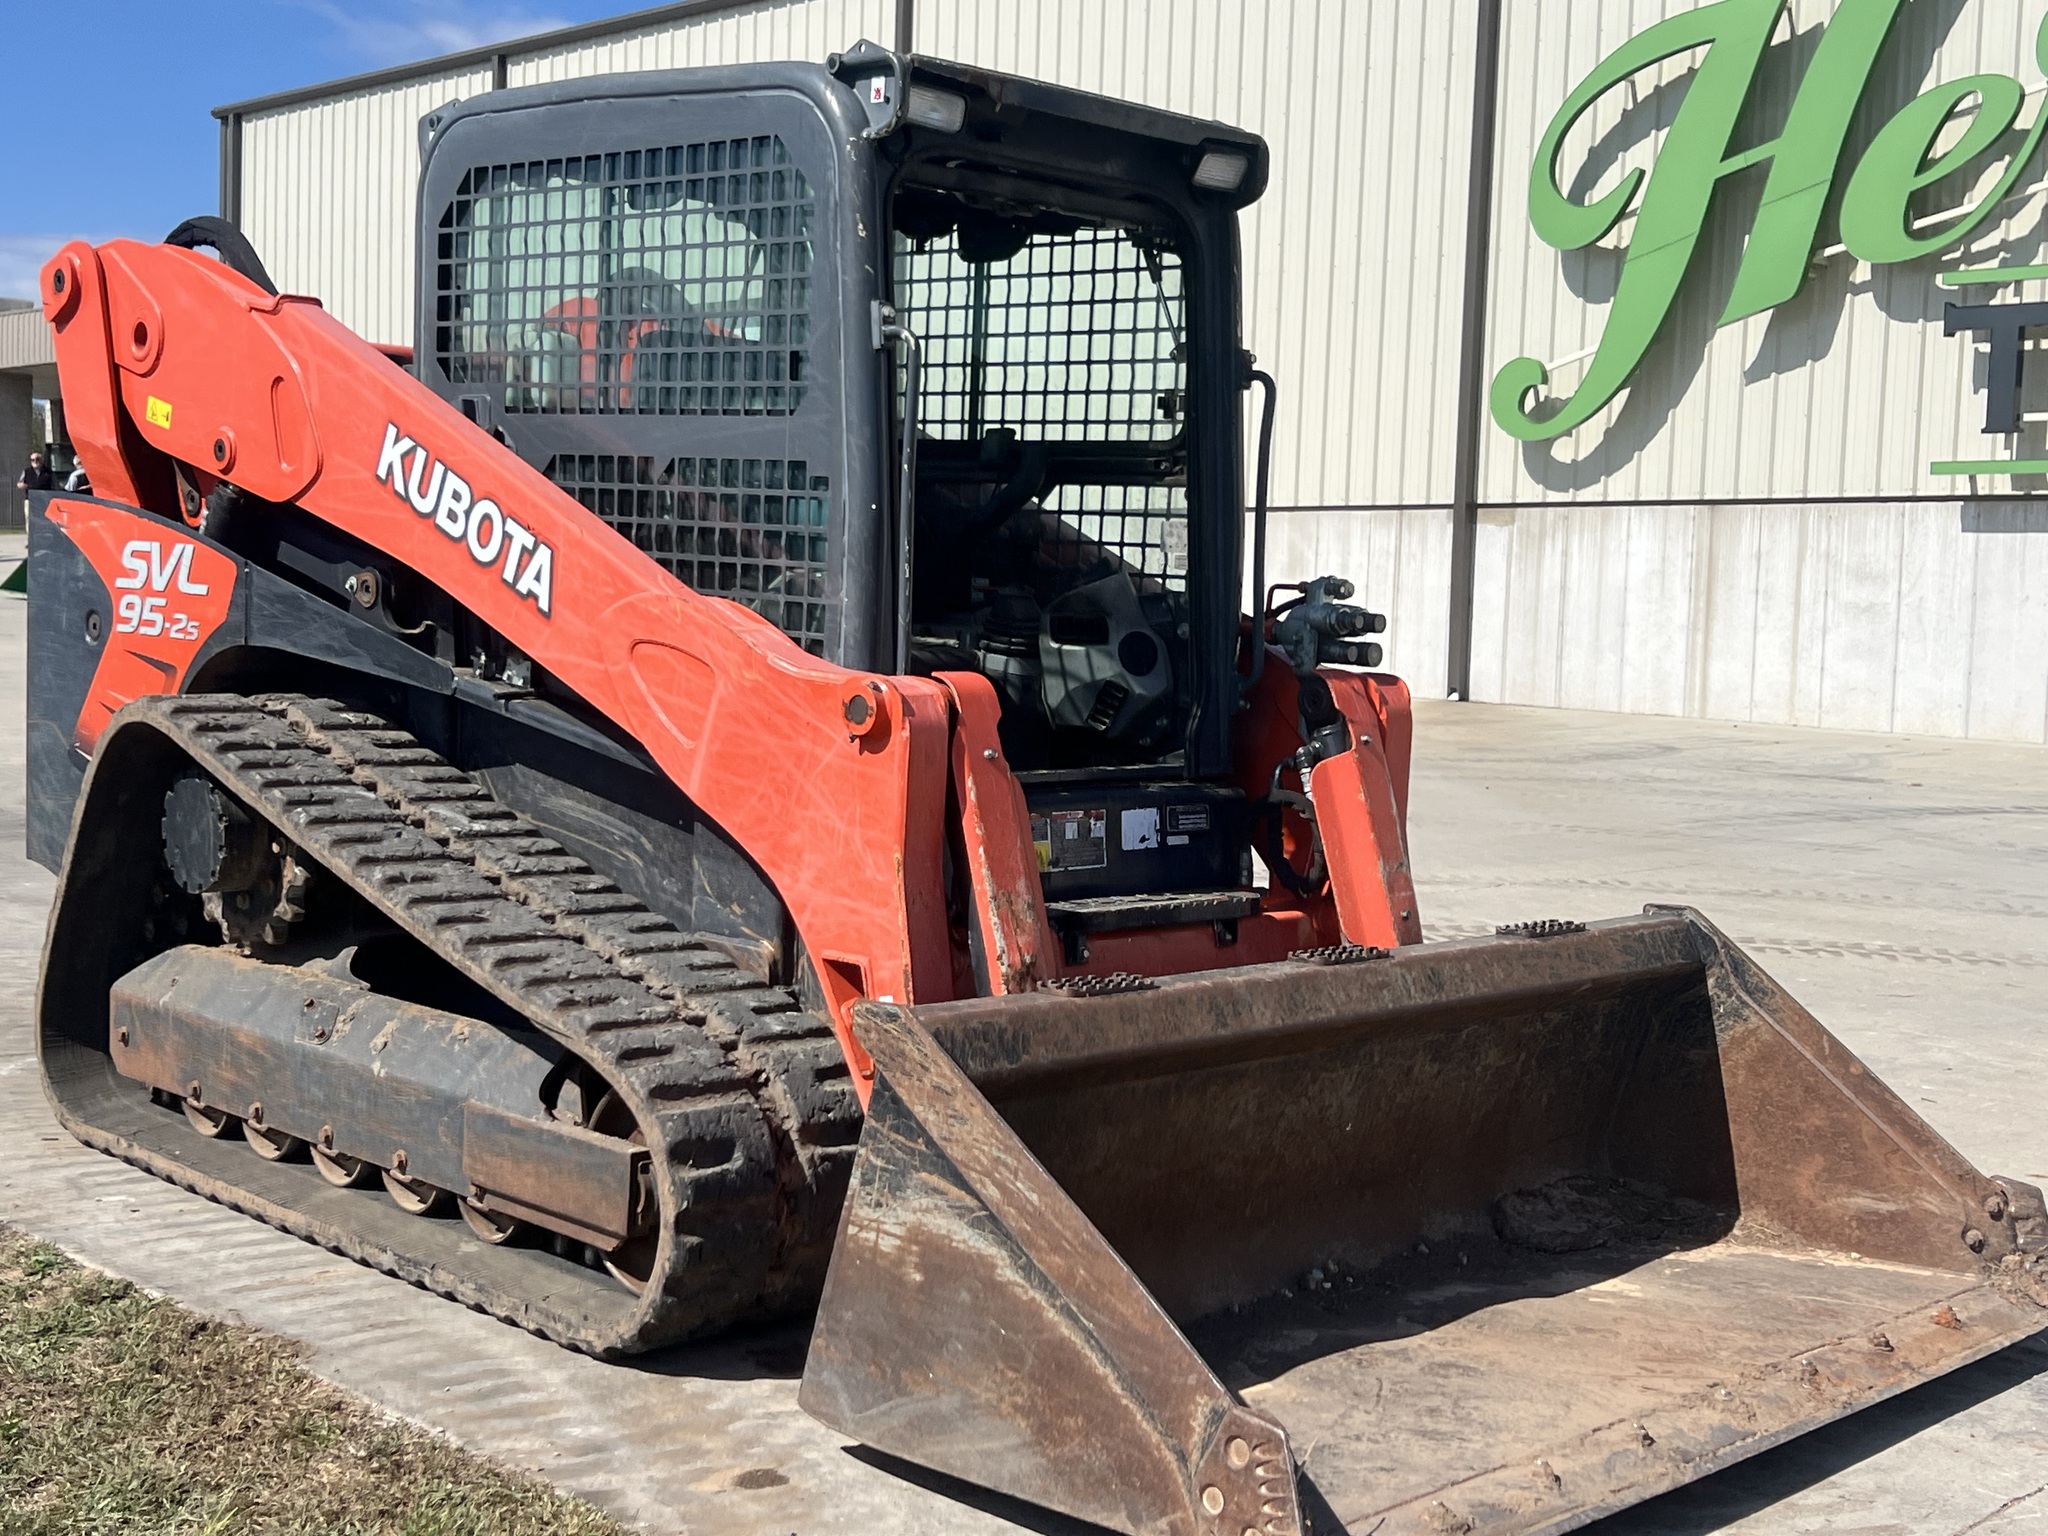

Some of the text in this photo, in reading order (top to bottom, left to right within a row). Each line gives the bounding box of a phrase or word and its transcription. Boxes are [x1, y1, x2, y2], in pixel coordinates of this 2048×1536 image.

[1491, 0, 2048, 440] He
[115, 541, 209, 596] SVL
[376, 422, 554, 616] KUBOTA
